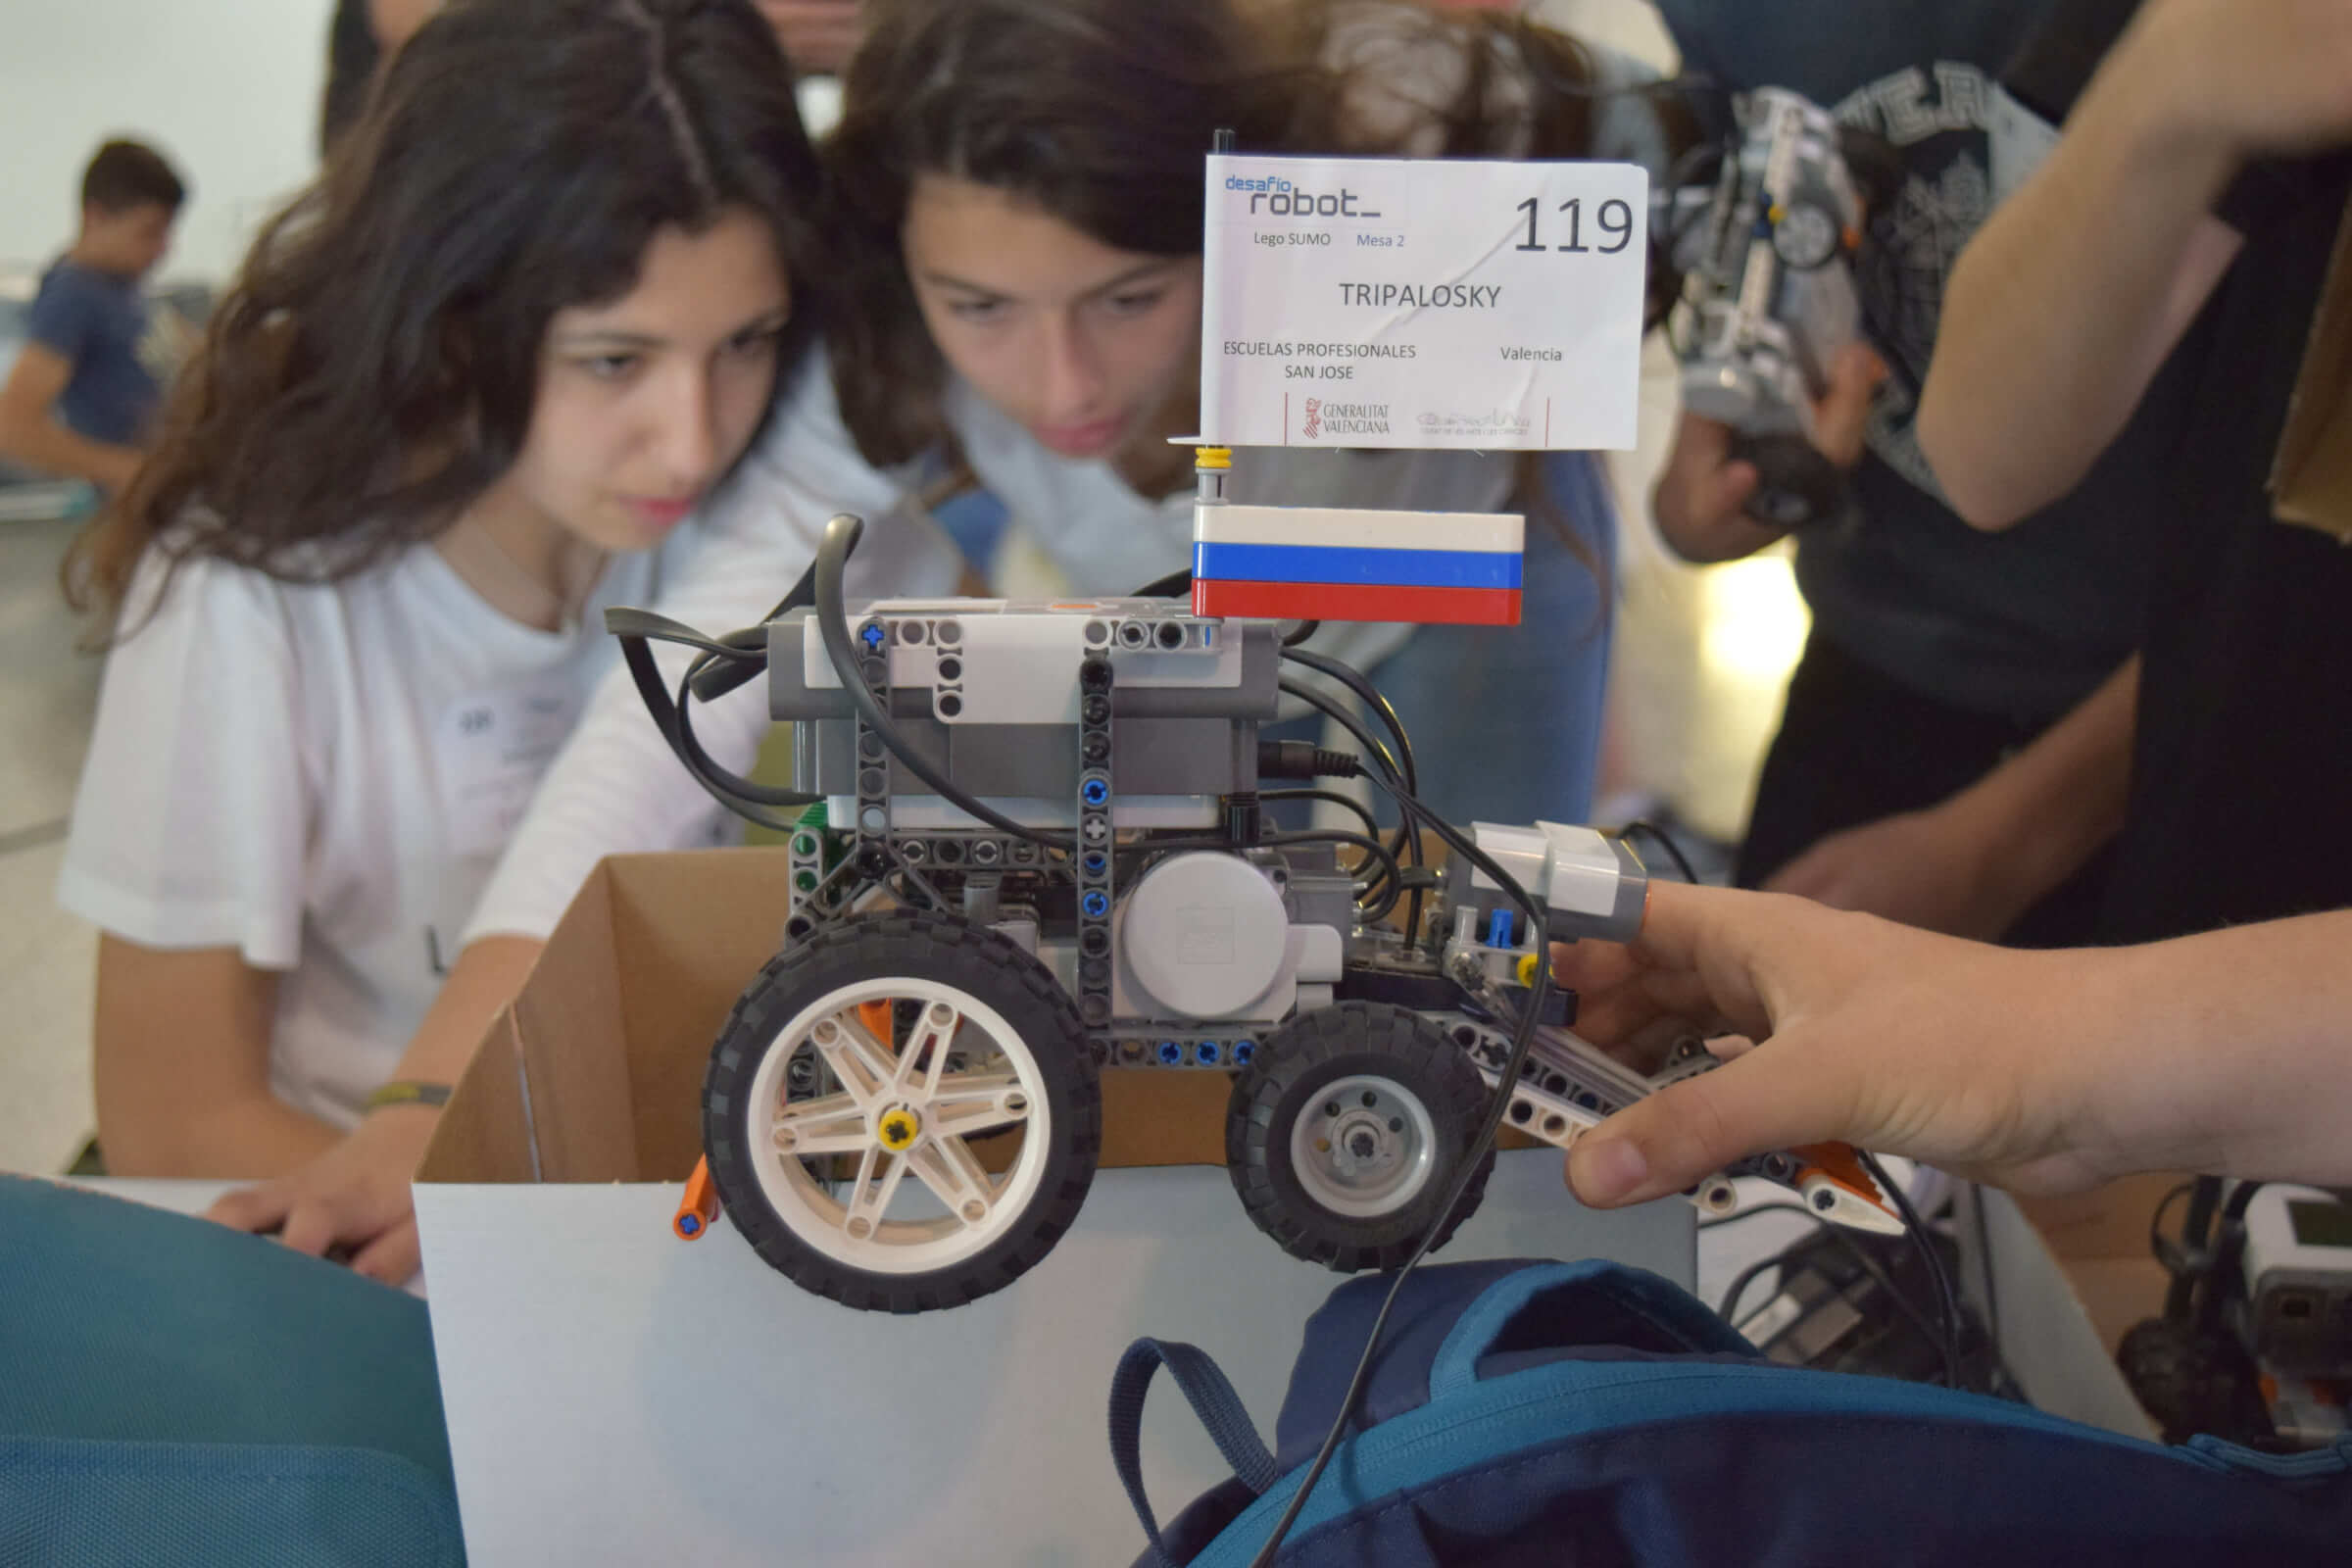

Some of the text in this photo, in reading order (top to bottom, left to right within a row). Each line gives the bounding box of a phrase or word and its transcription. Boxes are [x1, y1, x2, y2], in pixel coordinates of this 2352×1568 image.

[1515, 196, 1634, 255] 119
[1253, 231, 1332, 247] Lego SUMO
[1356, 234, 1405, 247] Mesa 2
[1339, 283, 1501, 309] TRIPALOSKY
[1224, 341, 1417, 359] ESCUELAS PROFESIONALES
[1500, 346, 1563, 362] Valencia
[1285, 365, 1354, 380] SAN JOSE
[1323, 403, 1390, 418] GENERALITAT
[1323, 419, 1390, 434] VALENCIANA
